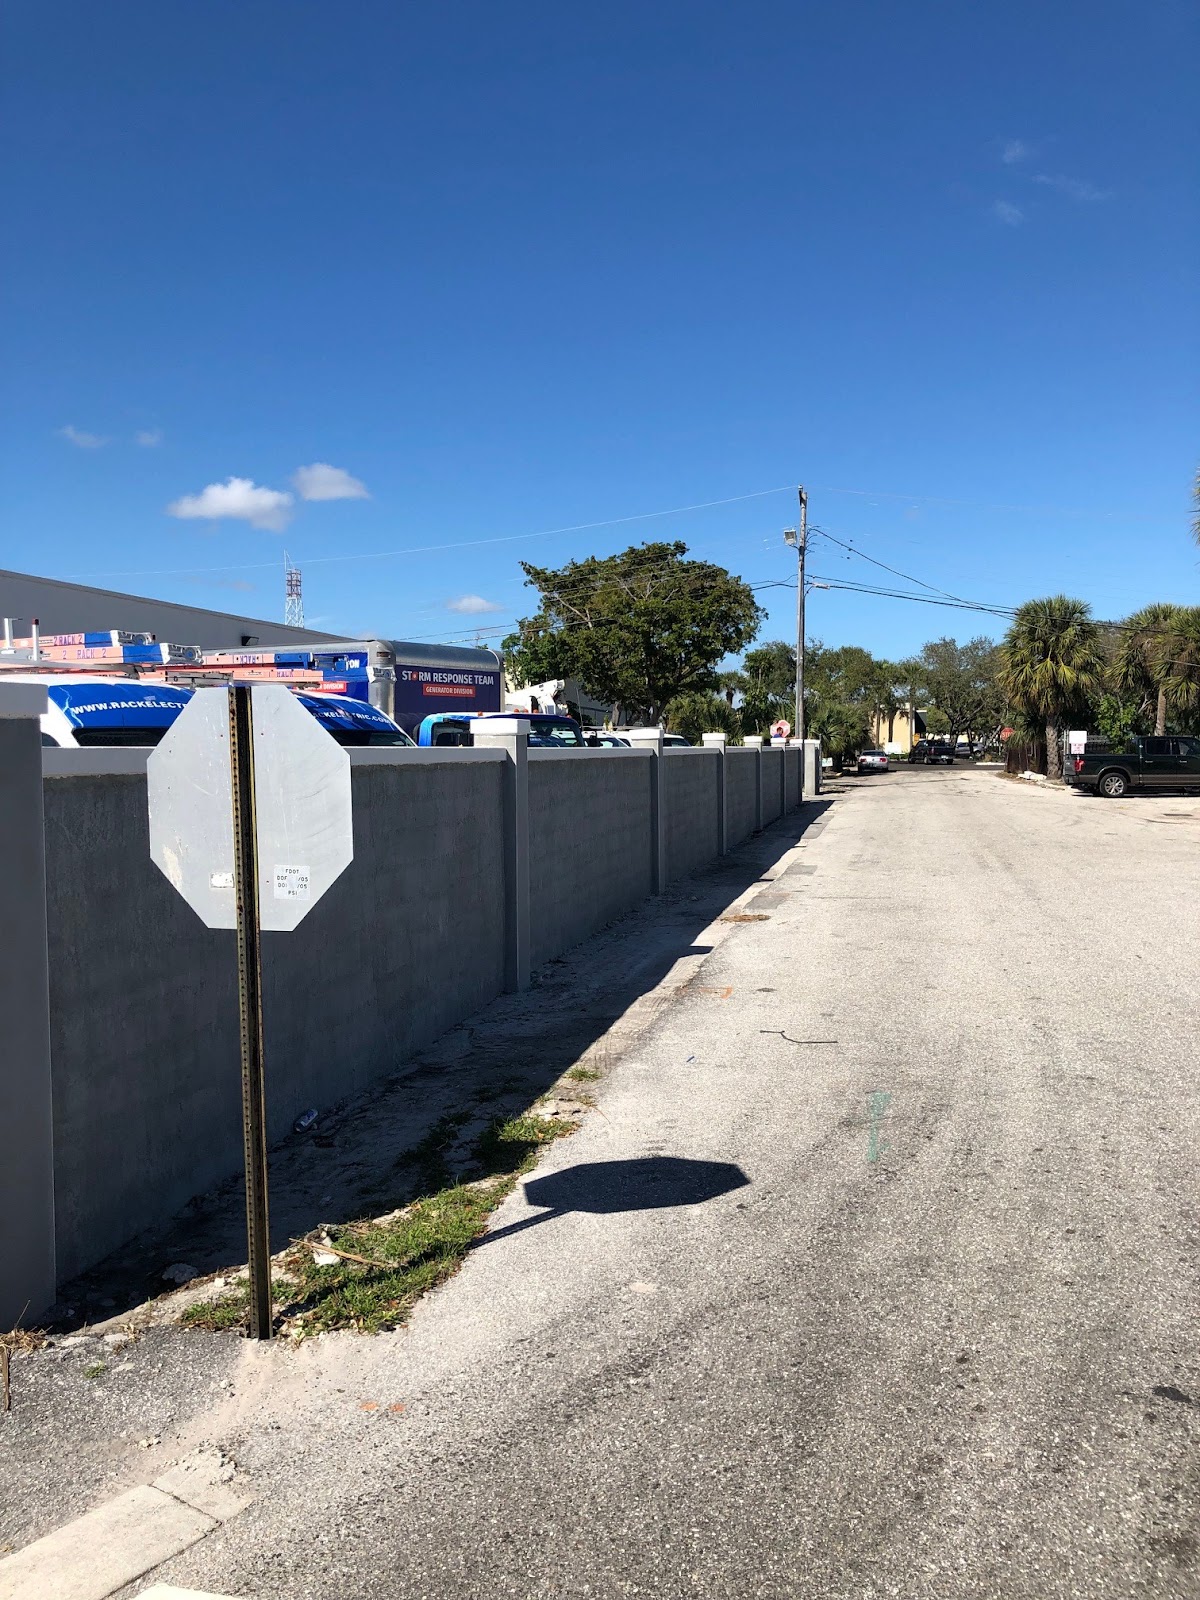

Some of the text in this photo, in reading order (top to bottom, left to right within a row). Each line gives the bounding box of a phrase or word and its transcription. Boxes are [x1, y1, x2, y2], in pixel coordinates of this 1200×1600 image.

[58, 635, 76, 646] RACK
[78, 634, 83, 644] 2
[76, 648, 95, 660] RACK
[101, 648, 107, 658] 2
[433, 672, 473, 684] RESPONSE
[474, 675, 494, 685] TEAM
[425, 686, 473, 695] GENERATOR DIVISION
